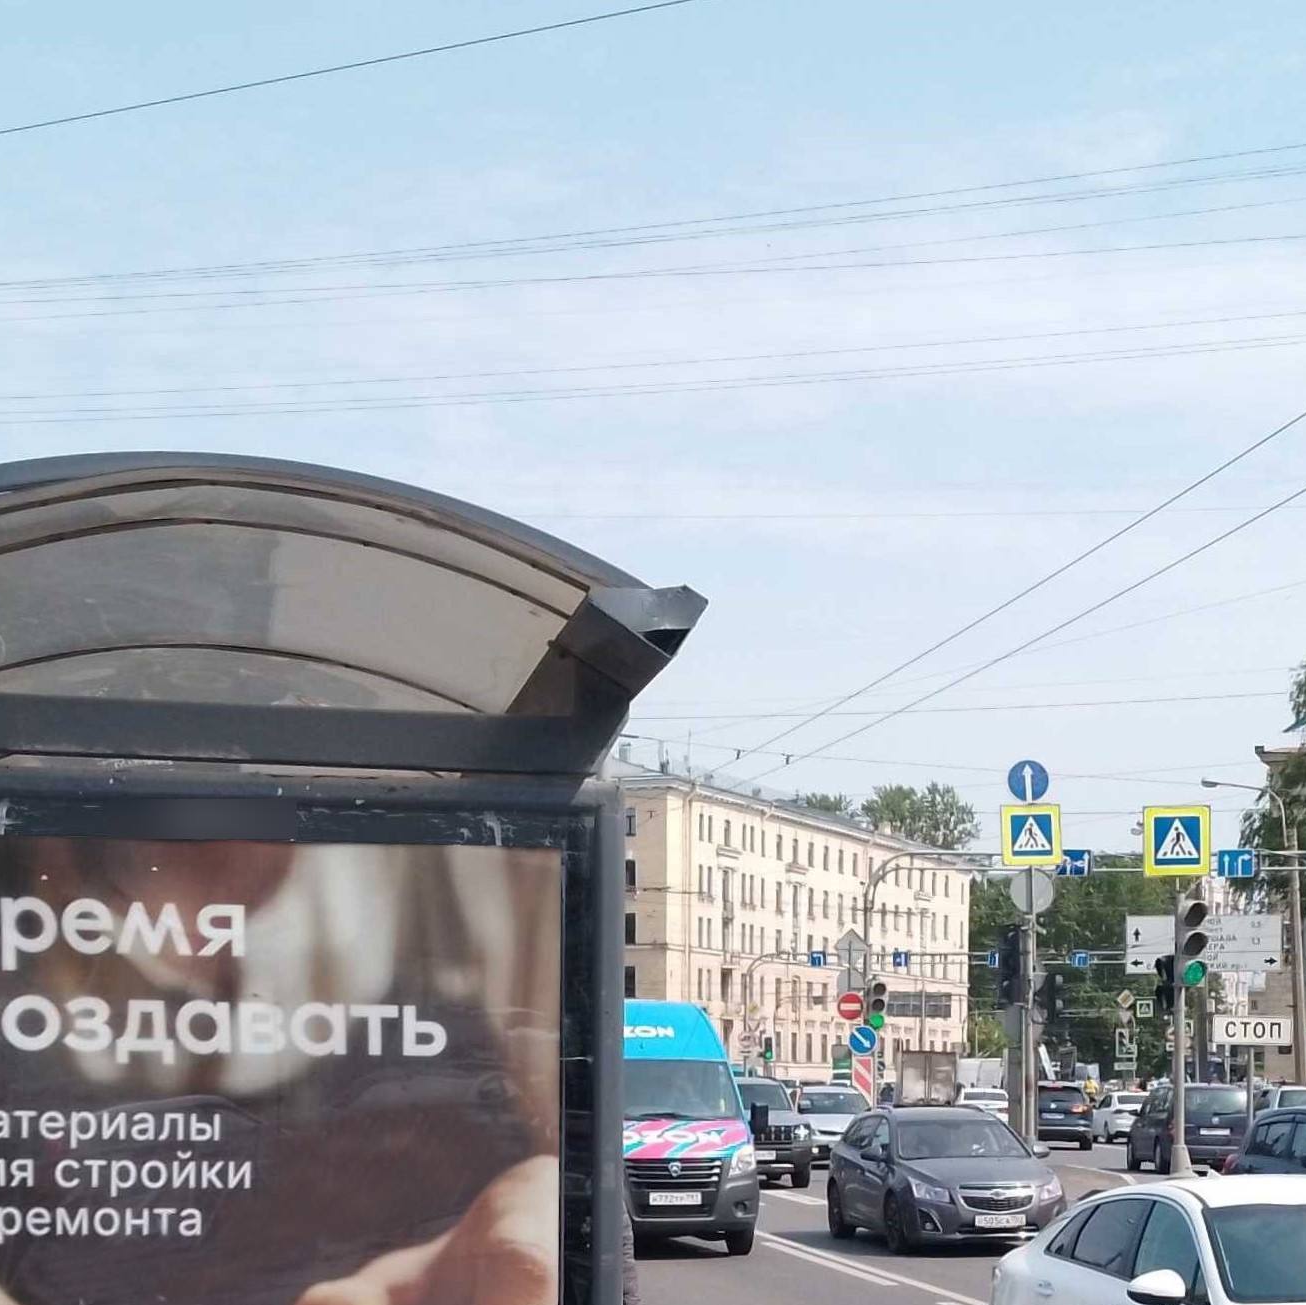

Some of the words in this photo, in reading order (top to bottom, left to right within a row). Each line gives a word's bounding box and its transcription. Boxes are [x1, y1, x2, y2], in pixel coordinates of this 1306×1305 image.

[623, 1025, 675, 1038] ZON
[1225, 1021, 1282, 1039] СТОП
[53, 1149, 254, 1195] стройки
